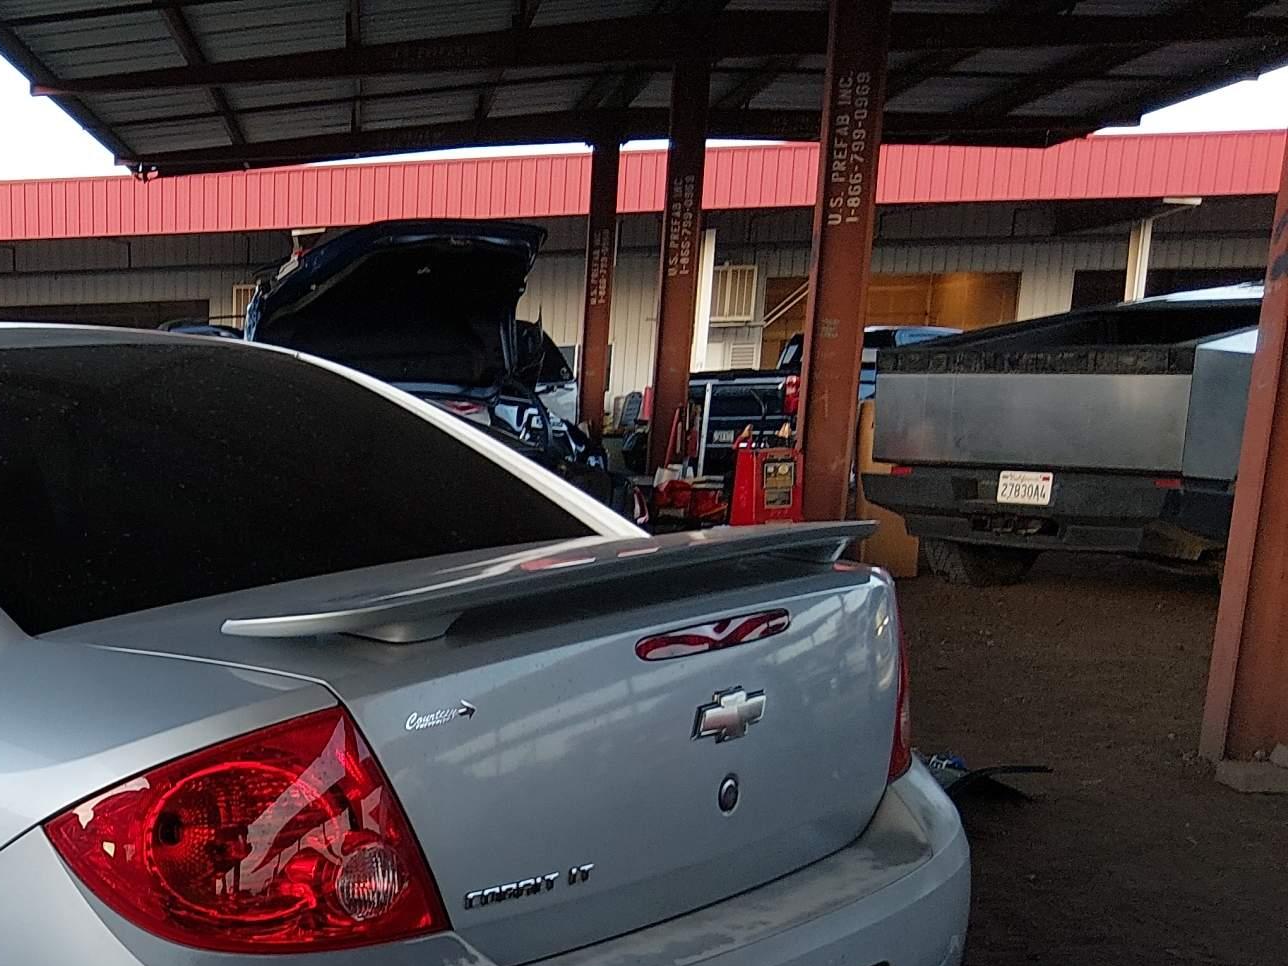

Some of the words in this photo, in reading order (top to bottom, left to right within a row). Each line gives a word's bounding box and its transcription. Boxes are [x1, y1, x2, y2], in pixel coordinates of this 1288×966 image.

[838, 70, 854, 105] INC.
[831, 114, 850, 183] PREFAB
[845, 71, 871, 223] 1-866-799-0969
[828, 191, 844, 225] U.S.
